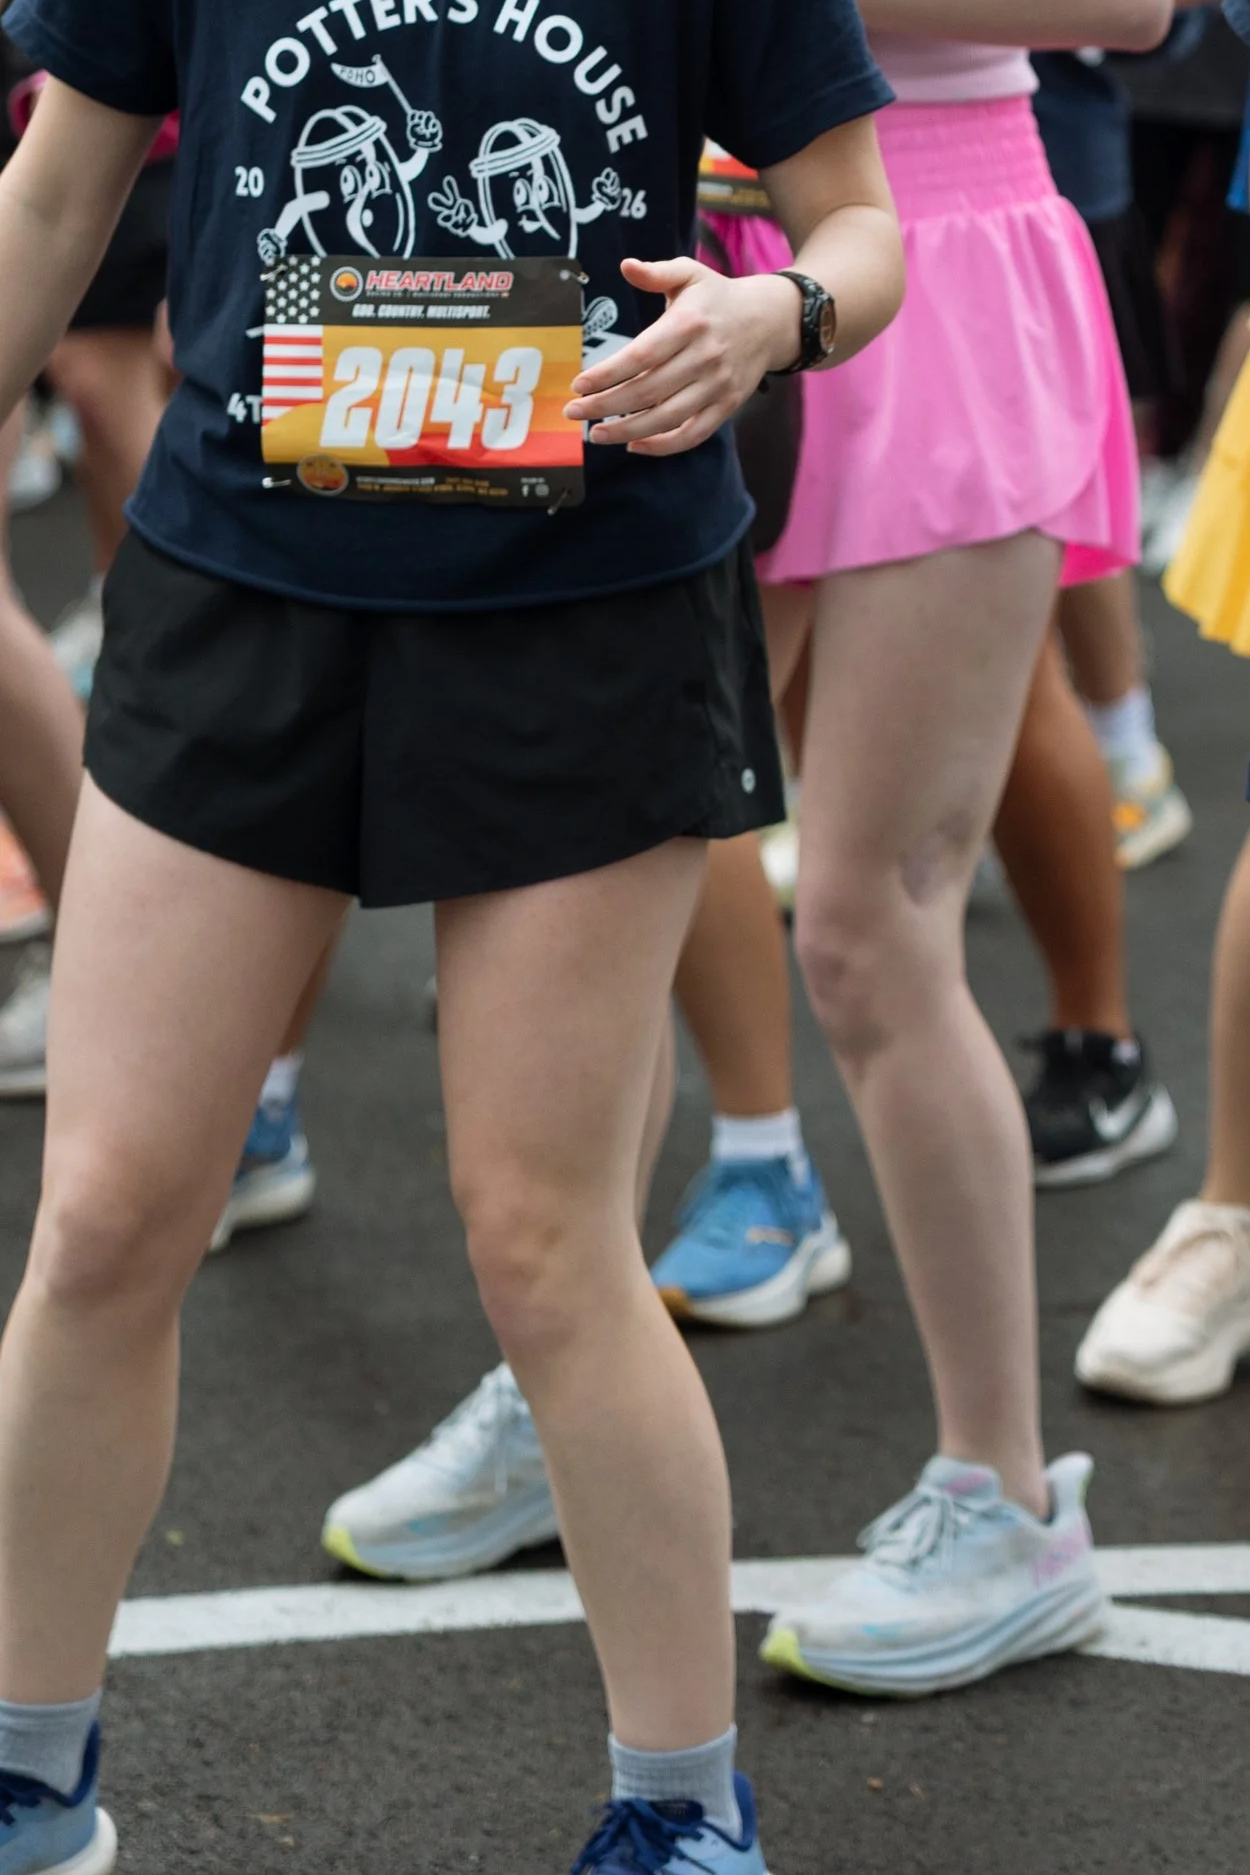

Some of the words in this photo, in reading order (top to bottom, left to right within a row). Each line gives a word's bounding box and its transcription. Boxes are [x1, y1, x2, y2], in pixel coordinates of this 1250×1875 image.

[234, 165, 265, 198] 20
[620, 187, 647, 219] 26
[365, 270, 514, 292] HEARTLAND
[318, 346, 543, 451] 2043
